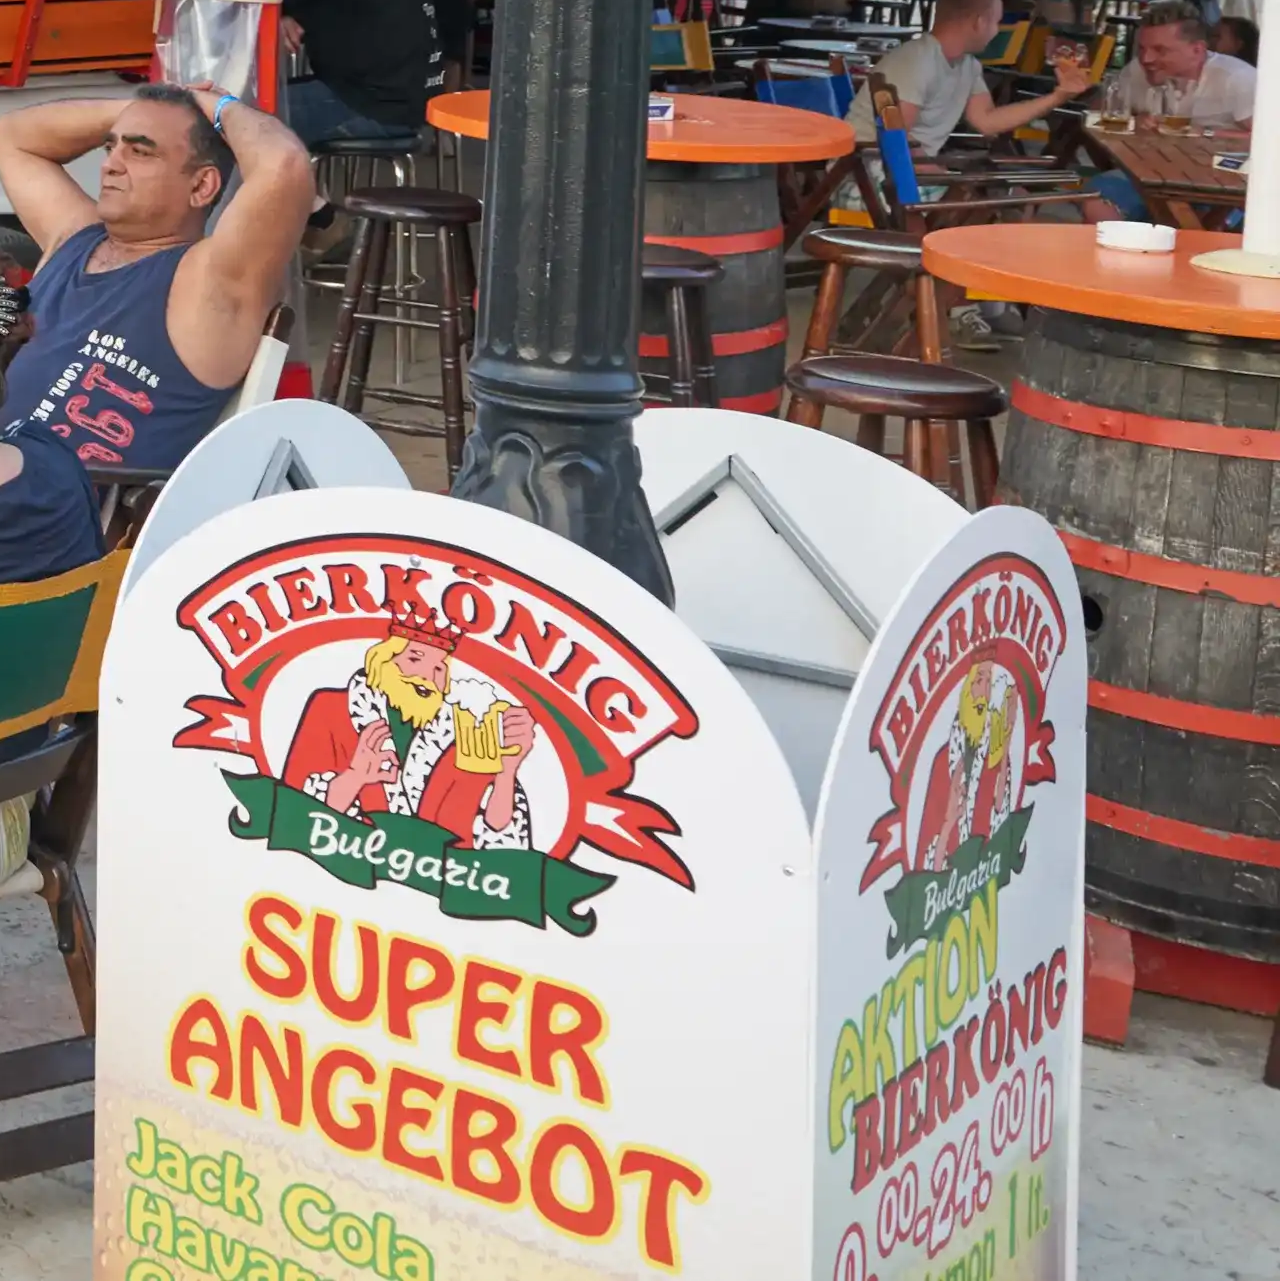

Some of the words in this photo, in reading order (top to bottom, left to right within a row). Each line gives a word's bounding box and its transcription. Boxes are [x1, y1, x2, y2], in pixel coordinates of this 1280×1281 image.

[29, 398, 56, 422] BE
[48, 362, 84, 398] COOL
[77, 343, 161, 389] ANGELES
[87, 329, 127, 351] LOS
[207, 561, 650, 737] BIERKÖNIG
[886, 571, 1054, 758] BIERKÖNIG
[308, 811, 513, 902] Bulgaria
[923, 850, 1002, 932] Bulgaria
[243, 895, 612, 1111] SUPER
[827, 875, 999, 1154] AKTION
[850, 945, 1068, 1196] BIERKÖNIG
[126, 1117, 264, 1226] Jack
[279, 1182, 435, 1281] Cola
[167, 995, 712, 1274] ANGEBOT
